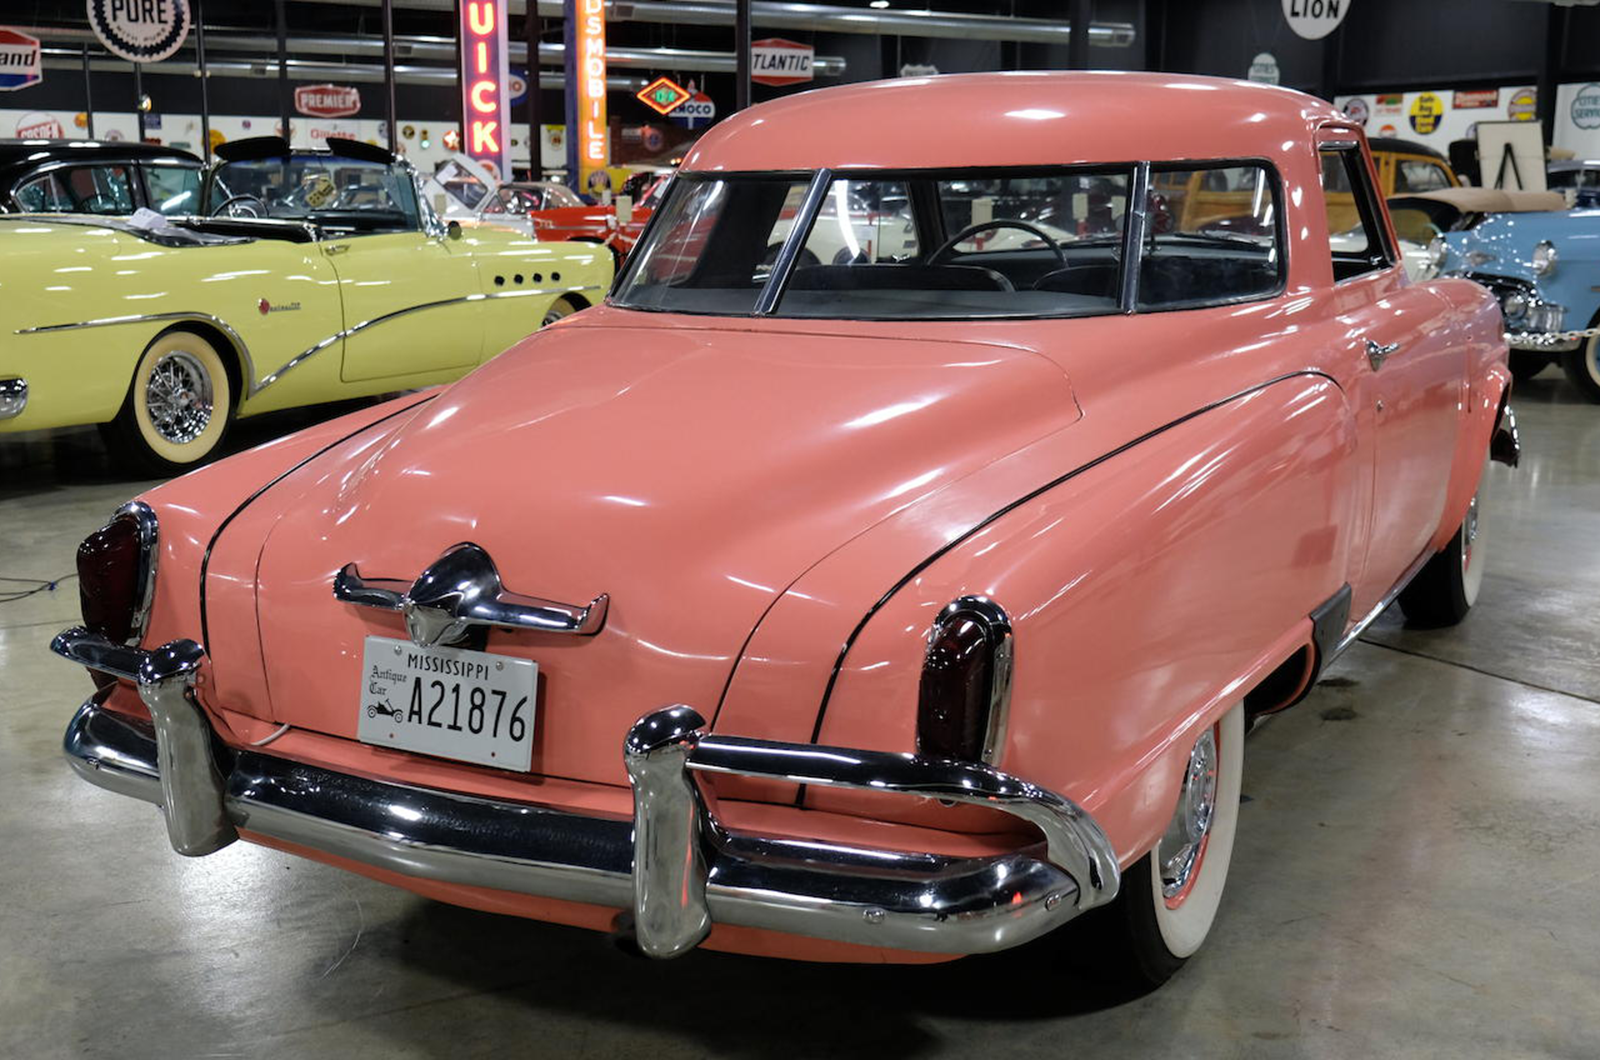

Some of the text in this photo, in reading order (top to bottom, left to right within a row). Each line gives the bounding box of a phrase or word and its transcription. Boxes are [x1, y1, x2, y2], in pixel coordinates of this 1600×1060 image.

[112, 0, 168, 24] PURE
[1290, 0, 1339, 19] LION
[0, 50, 37, 66] and
[752, 53, 810, 72] TLANTIC
[468, 2, 500, 153] UICK
[300, 92, 354, 109] PREMIER
[371, 665, 407, 685] Antique
[408, 654, 488, 680] MISSISSIPPI
[369, 682, 387, 696] Car
[407, 676, 528, 742] A21876
